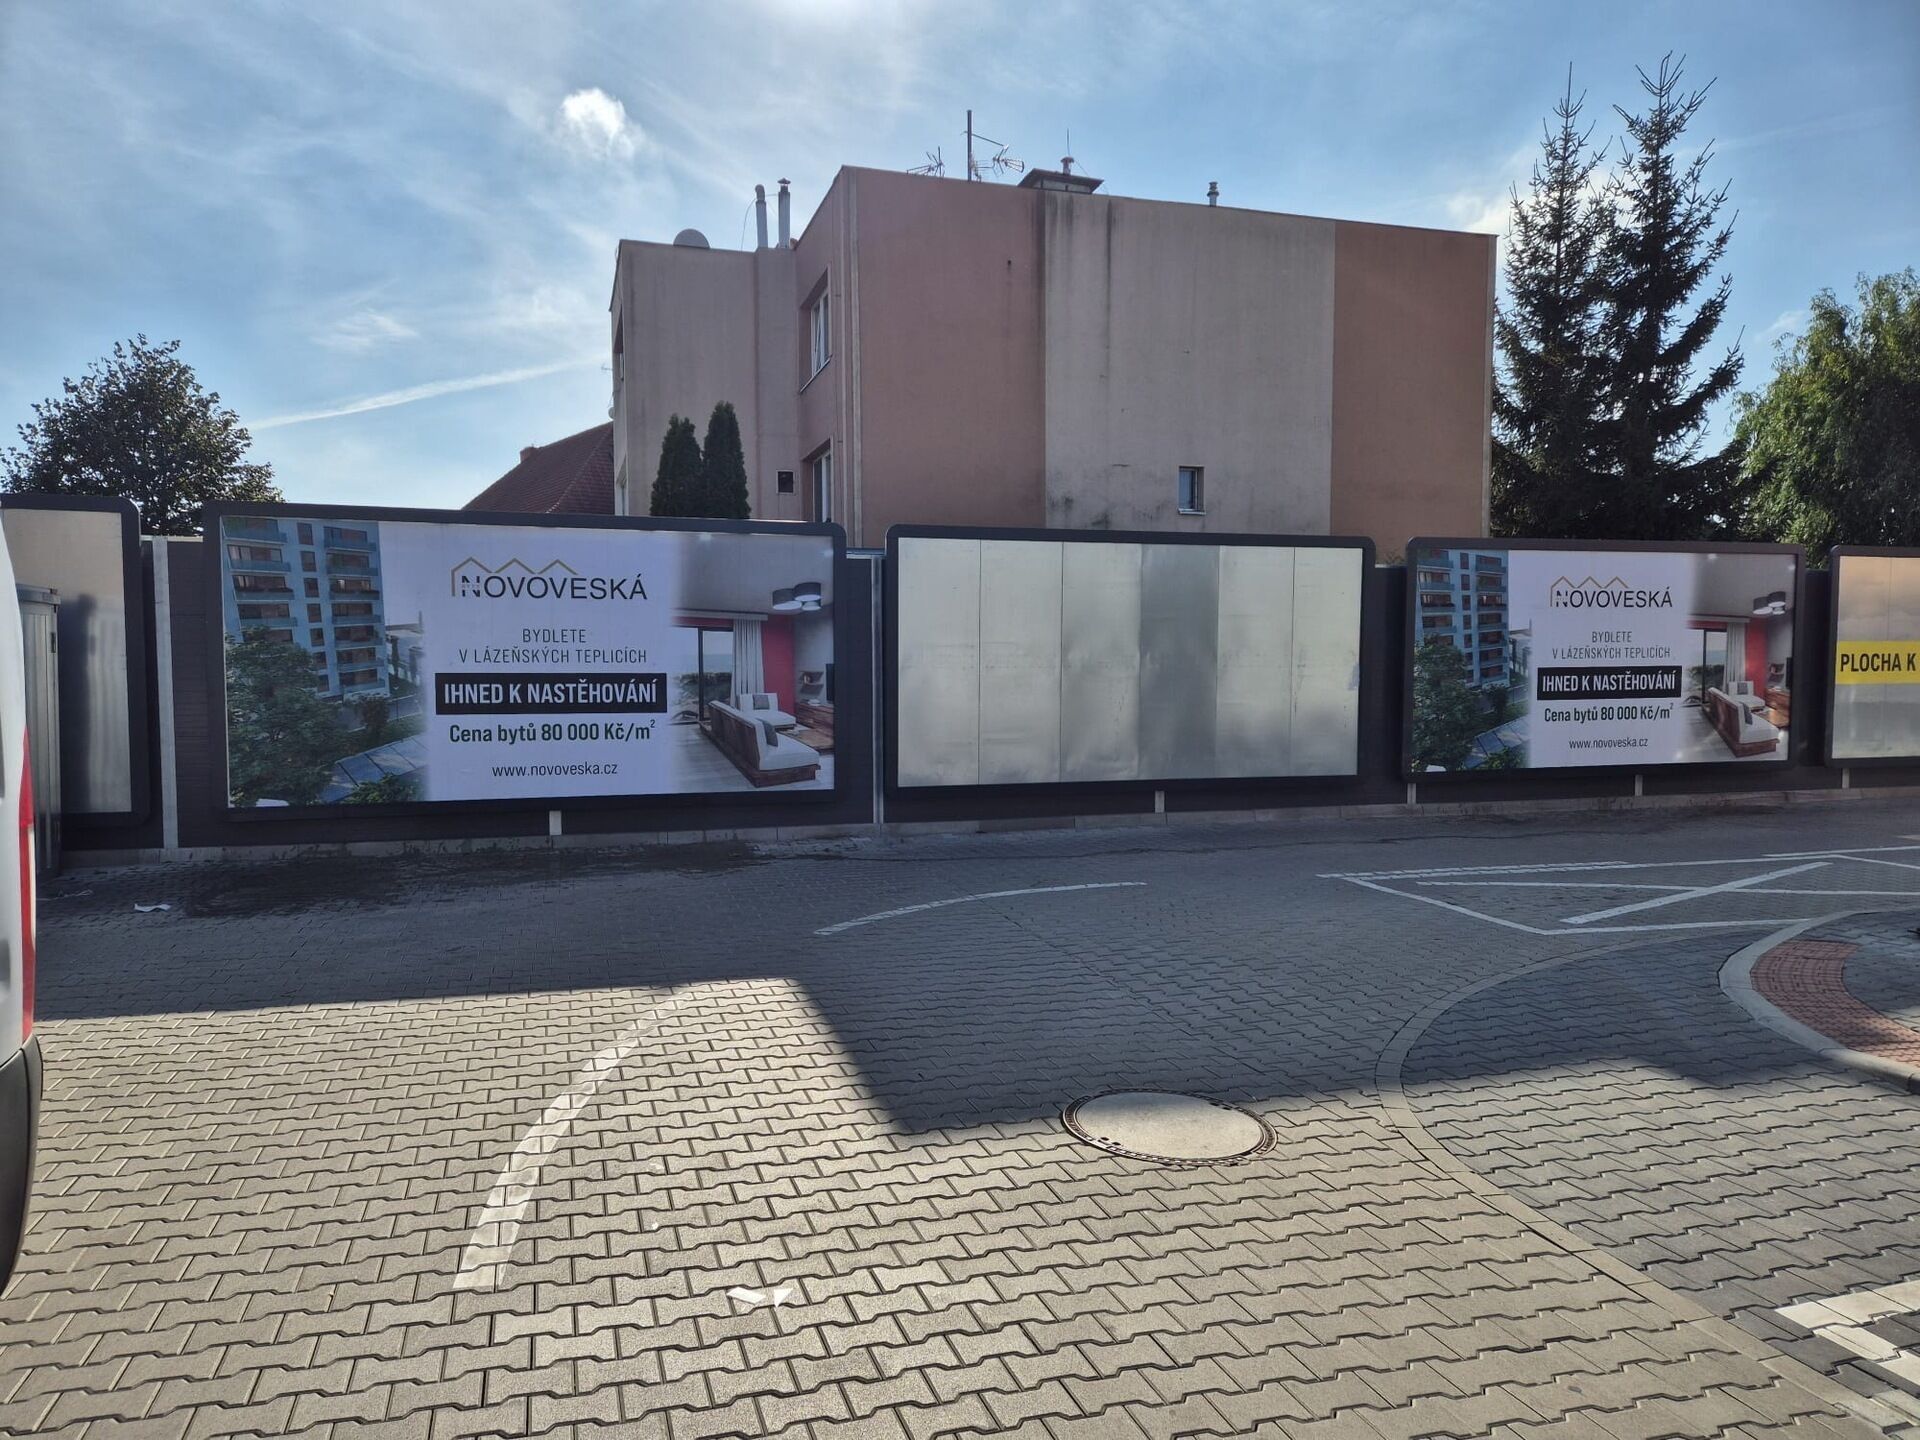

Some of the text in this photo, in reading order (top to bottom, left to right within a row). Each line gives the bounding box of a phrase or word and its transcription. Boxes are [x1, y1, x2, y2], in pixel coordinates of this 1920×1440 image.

[461, 573, 648, 600] NOVOVESKÁ
[1556, 586, 1673, 608] NOVOVESKÁ
[522, 628, 587, 643] BYDLETE
[1591, 631, 1633, 643] BYDLETE
[458, 645, 648, 664] V LÁZEŇSKÝCH TEPLICÍCH
[1552, 644, 1671, 660] V LÁZEŇSKÝCH TEPLICÍCH
[1840, 653, 1917, 672] PLOCHA K
[1542, 670, 1677, 692] IHNED K NASTĚHOVÁNÍ
[444, 678, 658, 704] IHNED K NASTĚHOVÁNÍ
[1544, 708, 1571, 722] Cena
[1574, 706, 1598, 724] bytů
[1600, 707, 1615, 721] 80
[1617, 706, 1638, 720] 000
[449, 724, 493, 743] Cena
[497, 722, 537, 745] bytů
[541, 723, 563, 741] 80
[567, 723, 600, 741] 000
[1568, 736, 1649, 750] www.novoveska.cz
[492, 761, 619, 777] www.novoveska.cz
